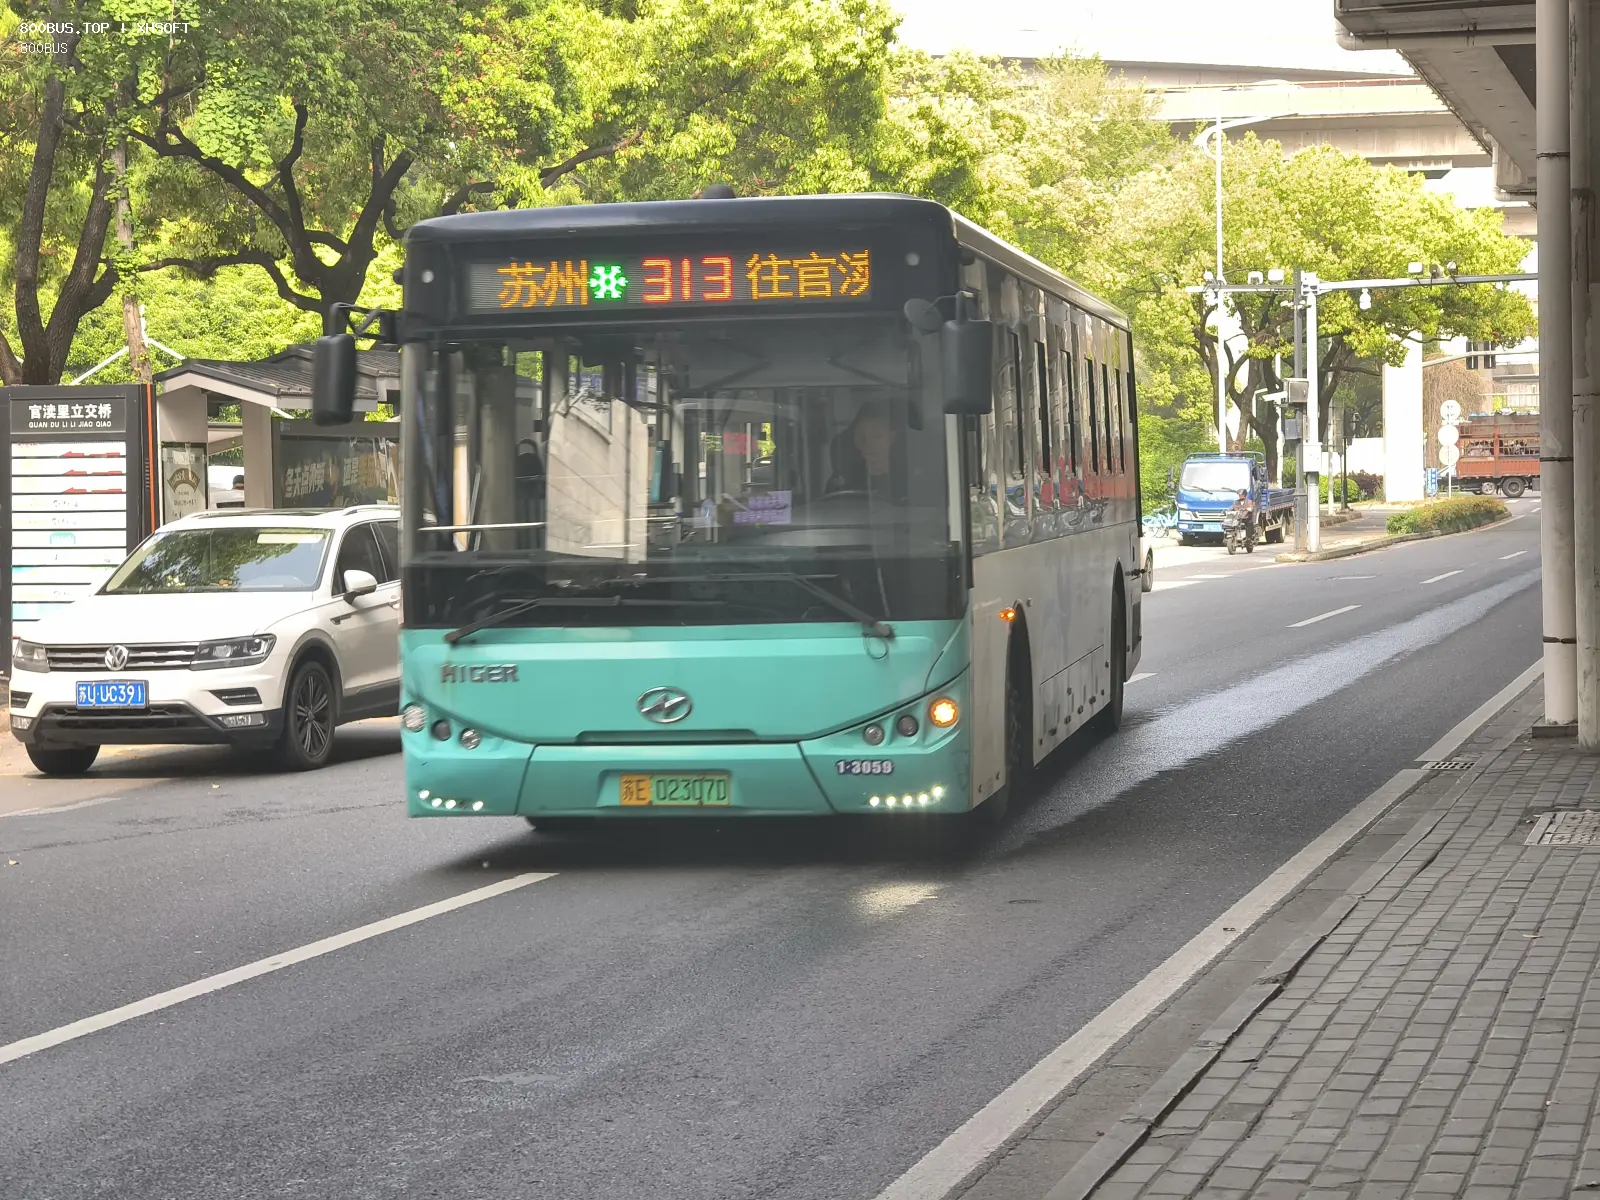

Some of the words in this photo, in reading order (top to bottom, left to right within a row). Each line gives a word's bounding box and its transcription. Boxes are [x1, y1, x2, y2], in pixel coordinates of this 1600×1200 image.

[496, 259, 589, 308] 苏州
[641, 257, 732, 303] 313
[28, 403, 112, 419] 官渎里立交桥
[78, 420, 93, 428] JIAO
[95, 420, 112, 428] QIAO
[440, 664, 520, 683] HIGER
